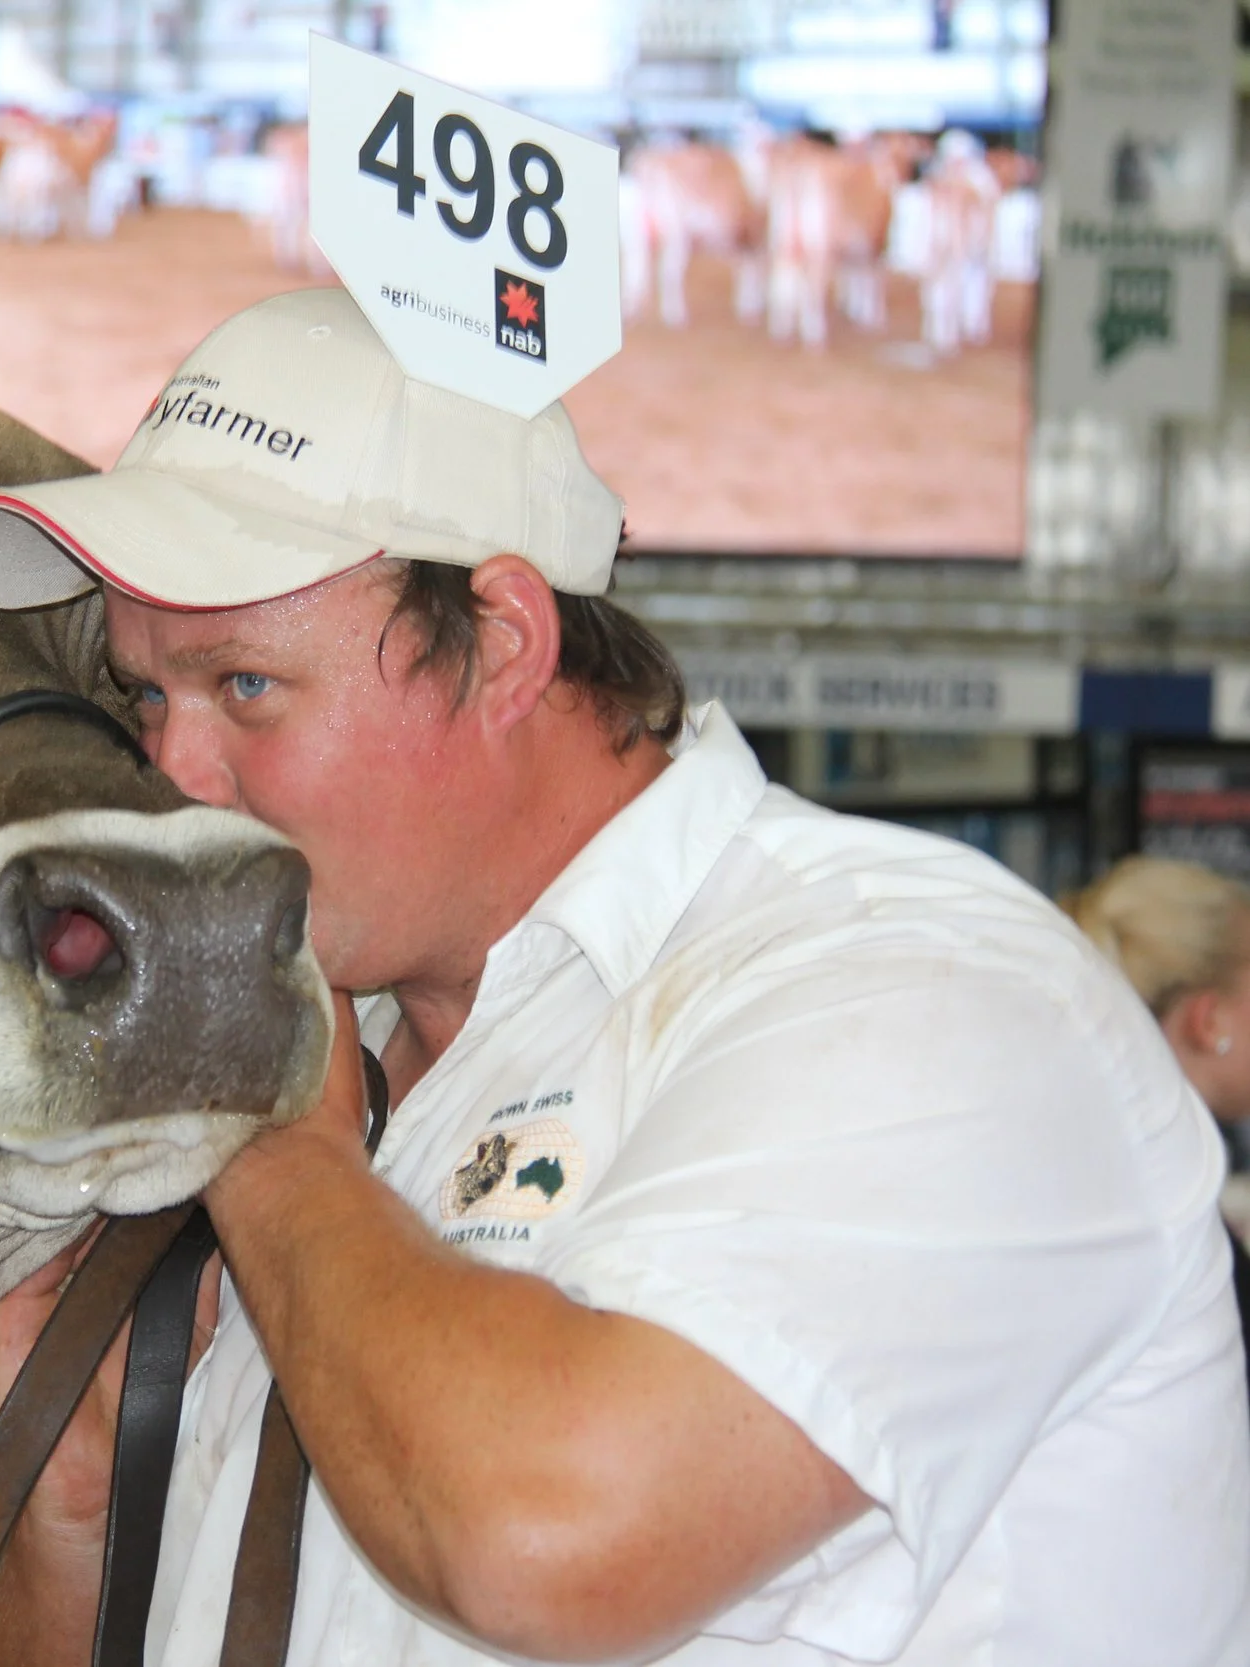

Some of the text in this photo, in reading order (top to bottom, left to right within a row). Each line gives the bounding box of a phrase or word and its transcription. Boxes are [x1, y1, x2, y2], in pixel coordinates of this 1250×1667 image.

[358, 89, 568, 272] 498
[380, 283, 491, 338] agribusiness
[501, 325, 542, 357] nab
[149, 391, 312, 461] yfarmer
[531, 1091, 574, 1112] SWISS
